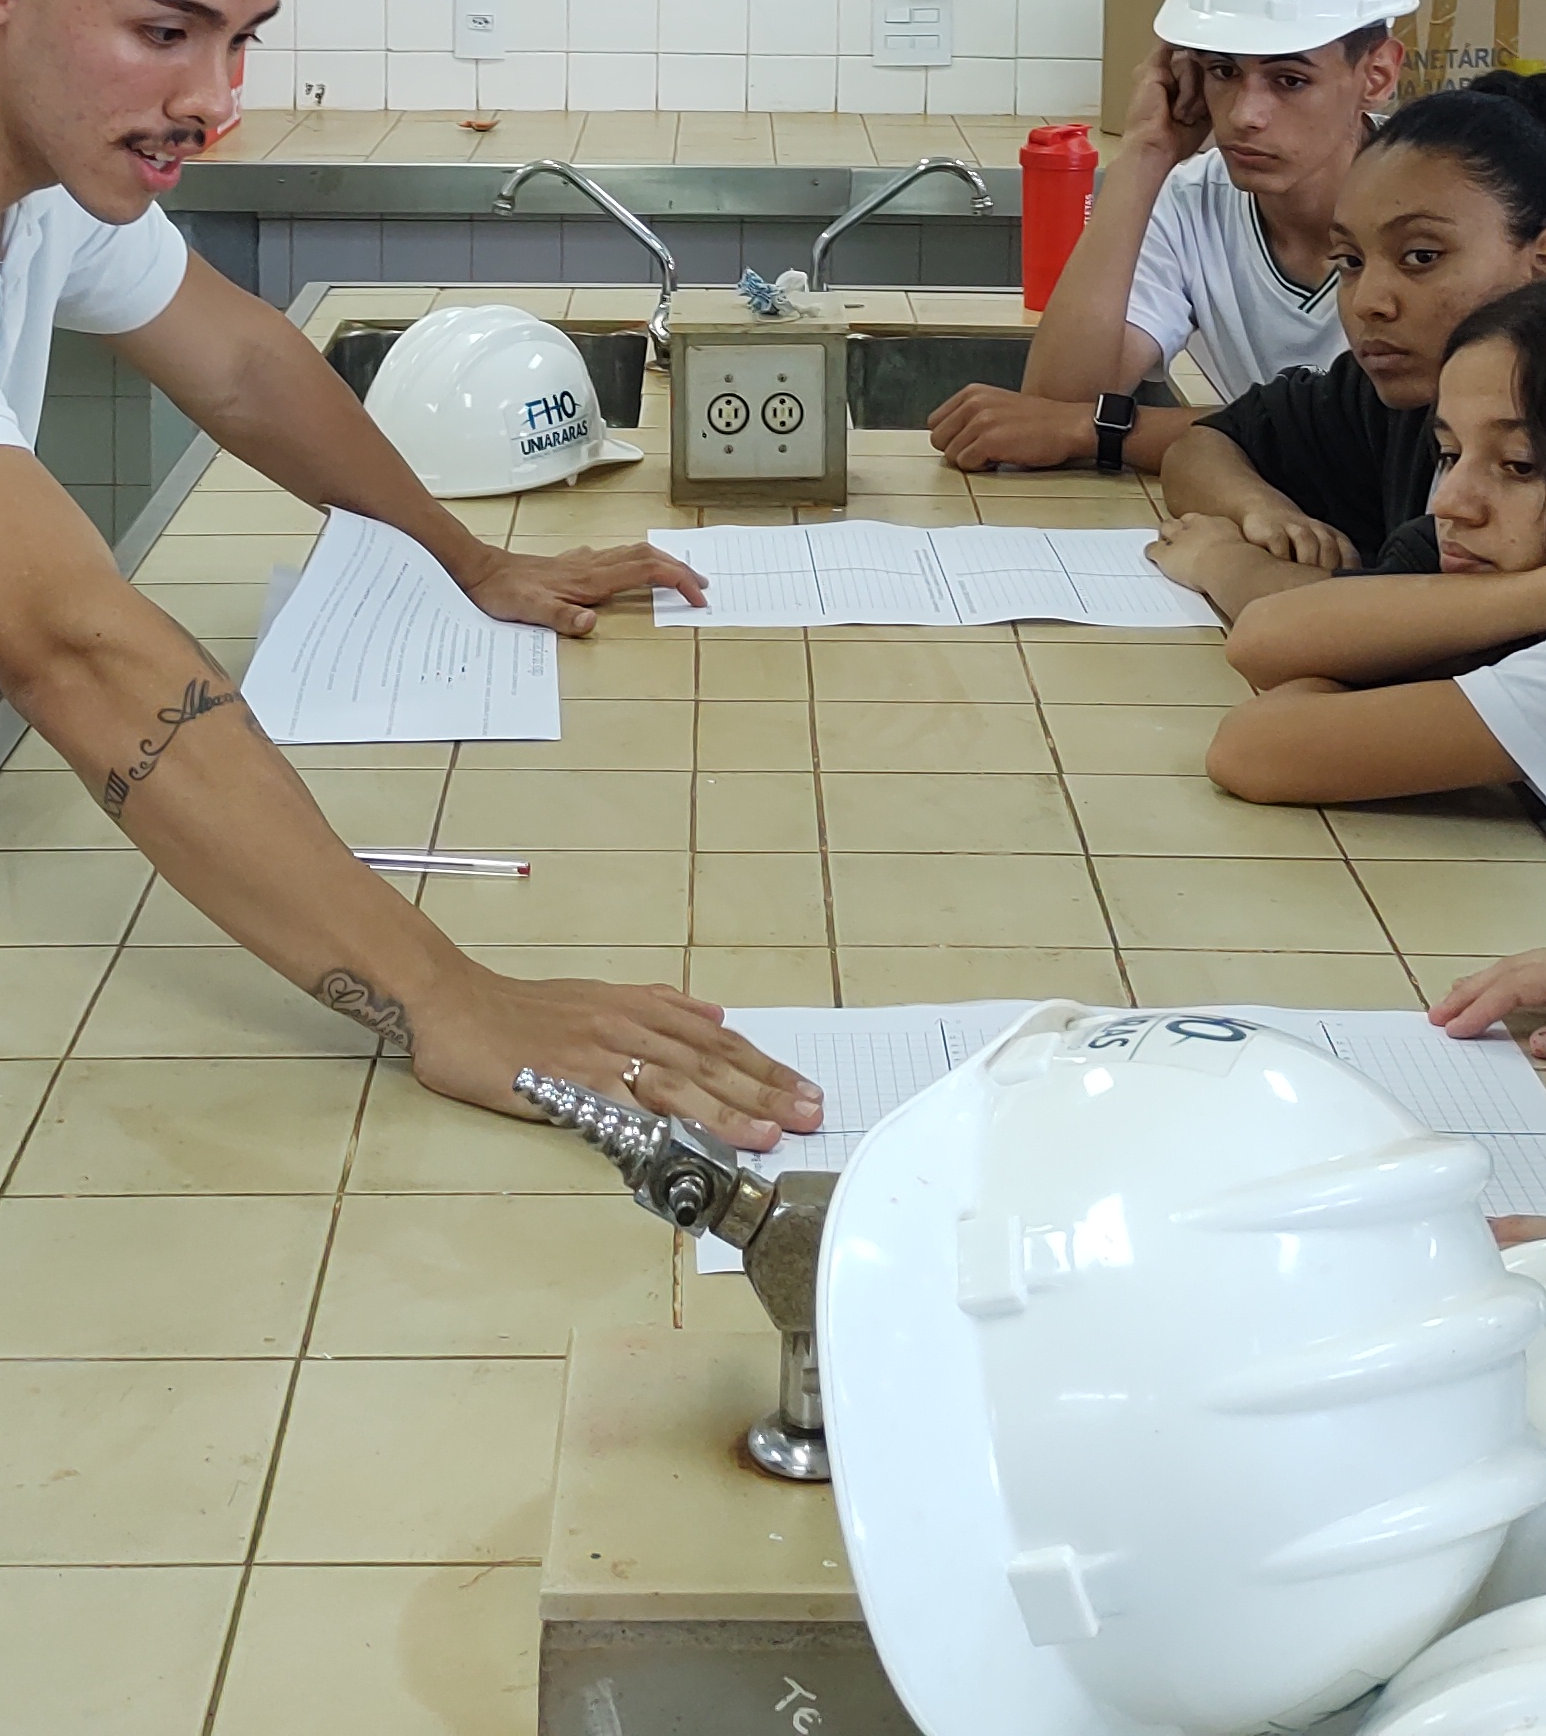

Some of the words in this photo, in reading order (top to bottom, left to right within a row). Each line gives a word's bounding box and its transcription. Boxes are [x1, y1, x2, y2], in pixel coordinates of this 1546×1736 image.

[1401, 42, 1515, 71] ANETÁRIO
[522, 390, 579, 430] FHO
[520, 420, 588, 455] UNIARARAS
